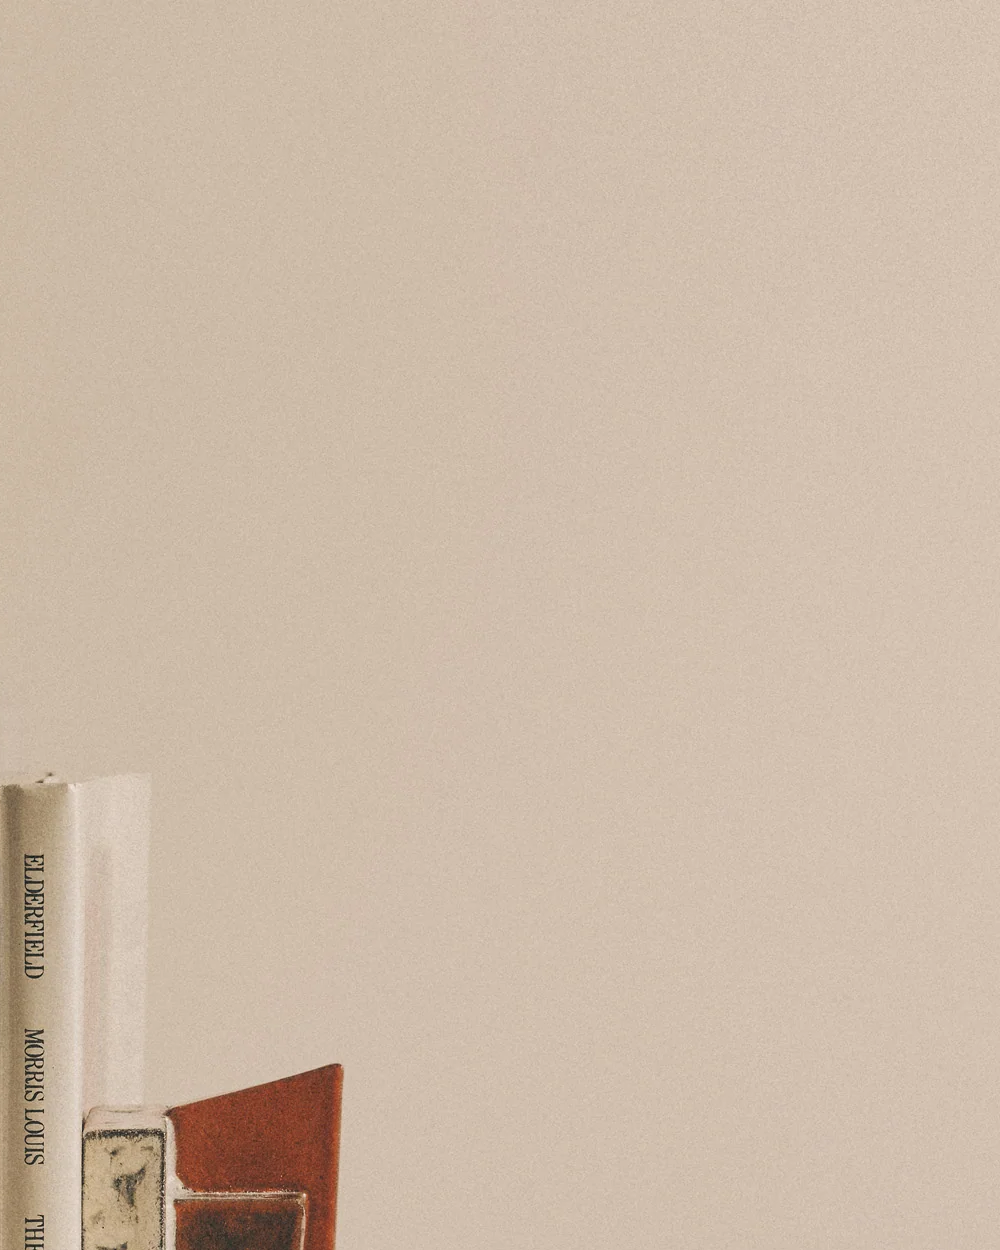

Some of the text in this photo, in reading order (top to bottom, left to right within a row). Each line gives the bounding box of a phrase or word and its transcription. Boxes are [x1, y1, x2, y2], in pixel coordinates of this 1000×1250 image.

[23, 853, 45, 980] ELDERFIELD
[23, 1028, 45, 1167] MORRIS LOUIS
